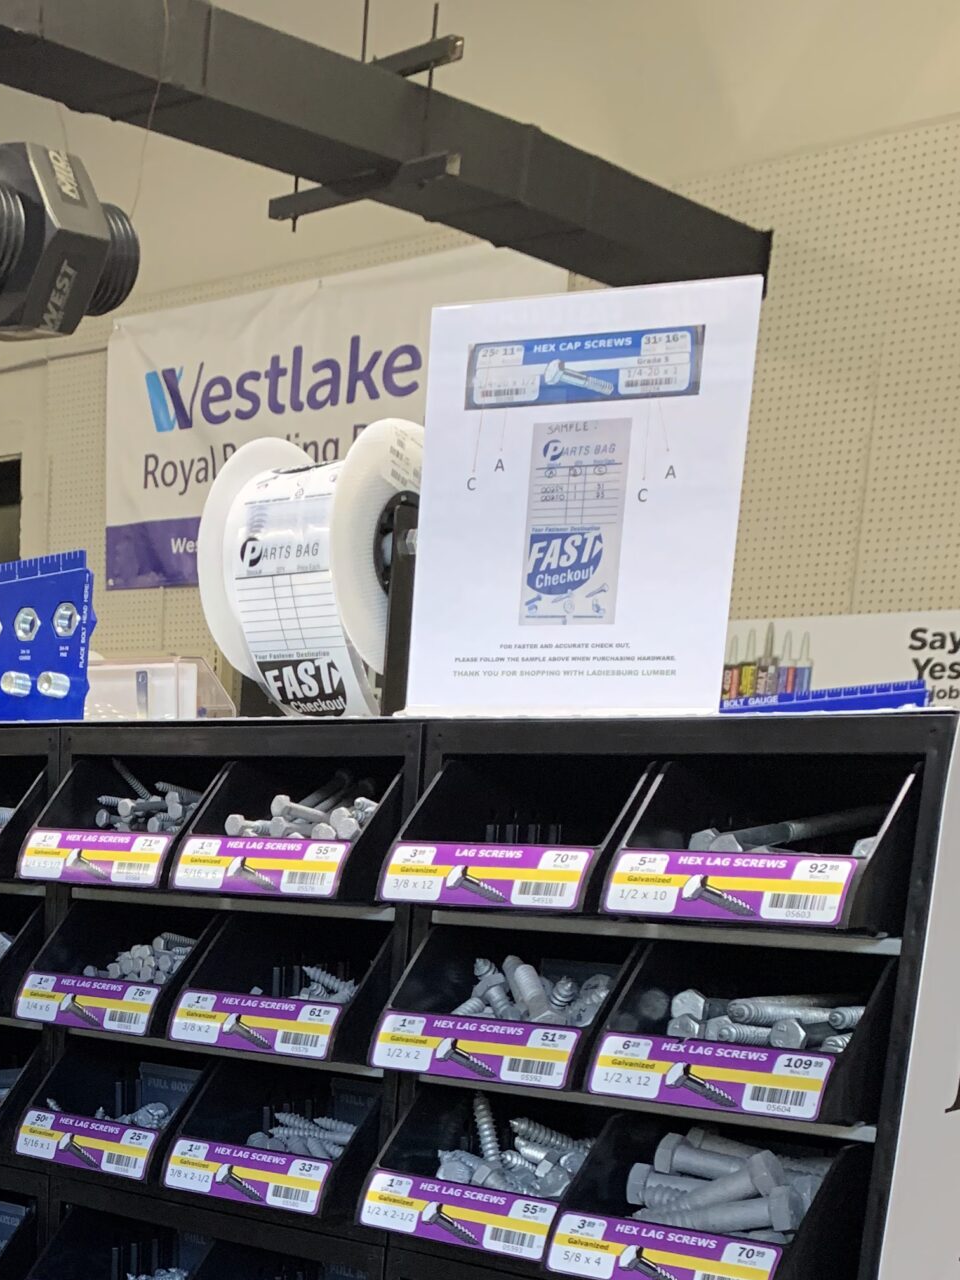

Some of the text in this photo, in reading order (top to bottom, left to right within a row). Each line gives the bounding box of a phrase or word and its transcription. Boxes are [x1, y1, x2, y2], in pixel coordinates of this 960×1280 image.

[533, 337, 632, 353] HEX CAP SCREWS
[145, 335, 422, 432] Westlake
[594, 443, 616, 455] BAG
[143, 445, 217, 495] Royal
[494, 458, 504, 472] A
[665, 465, 676, 478] A
[466, 478, 476, 491] C
[638, 488, 648, 502] C
[295, 542, 319, 558] BAG
[528, 530, 603, 573] FAST
[535, 565, 595, 588] Checkout
[265, 659, 334, 701] FAST
[289, 696, 347, 716] Checkout
[723, 695, 779, 709] BOLT GAUGE
[226, 841, 303, 851] HEX LAG SCREWS
[455, 849, 523, 859] LAG SCREWS
[678, 856, 788, 869] HEX LAG SCREWS
[393, 879, 410, 889] 3/8
[421, 881, 434, 889] 12
[627, 875, 672, 884] Galvanized
[619, 889, 637, 899] 1/2
[653, 891, 667, 901] 10
[433, 1020, 525, 1036] HEX LAG SCREWS
[661, 1042, 768, 1061] HEX LAG SCREWS
[611, 1058, 655, 1070] Galvanized
[603, 1073, 623, 1083] 1/2
[637, 1075, 650, 1086] 12
[215, 1146, 287, 1165] HEX LAG SCREWS
[615, 1224, 717, 1249] HEX LAG SCREWS
[568, 1238, 609, 1250] Galvanized
[563, 1250, 581, 1262] 5/8
[594, 1256, 601, 1266] 4
